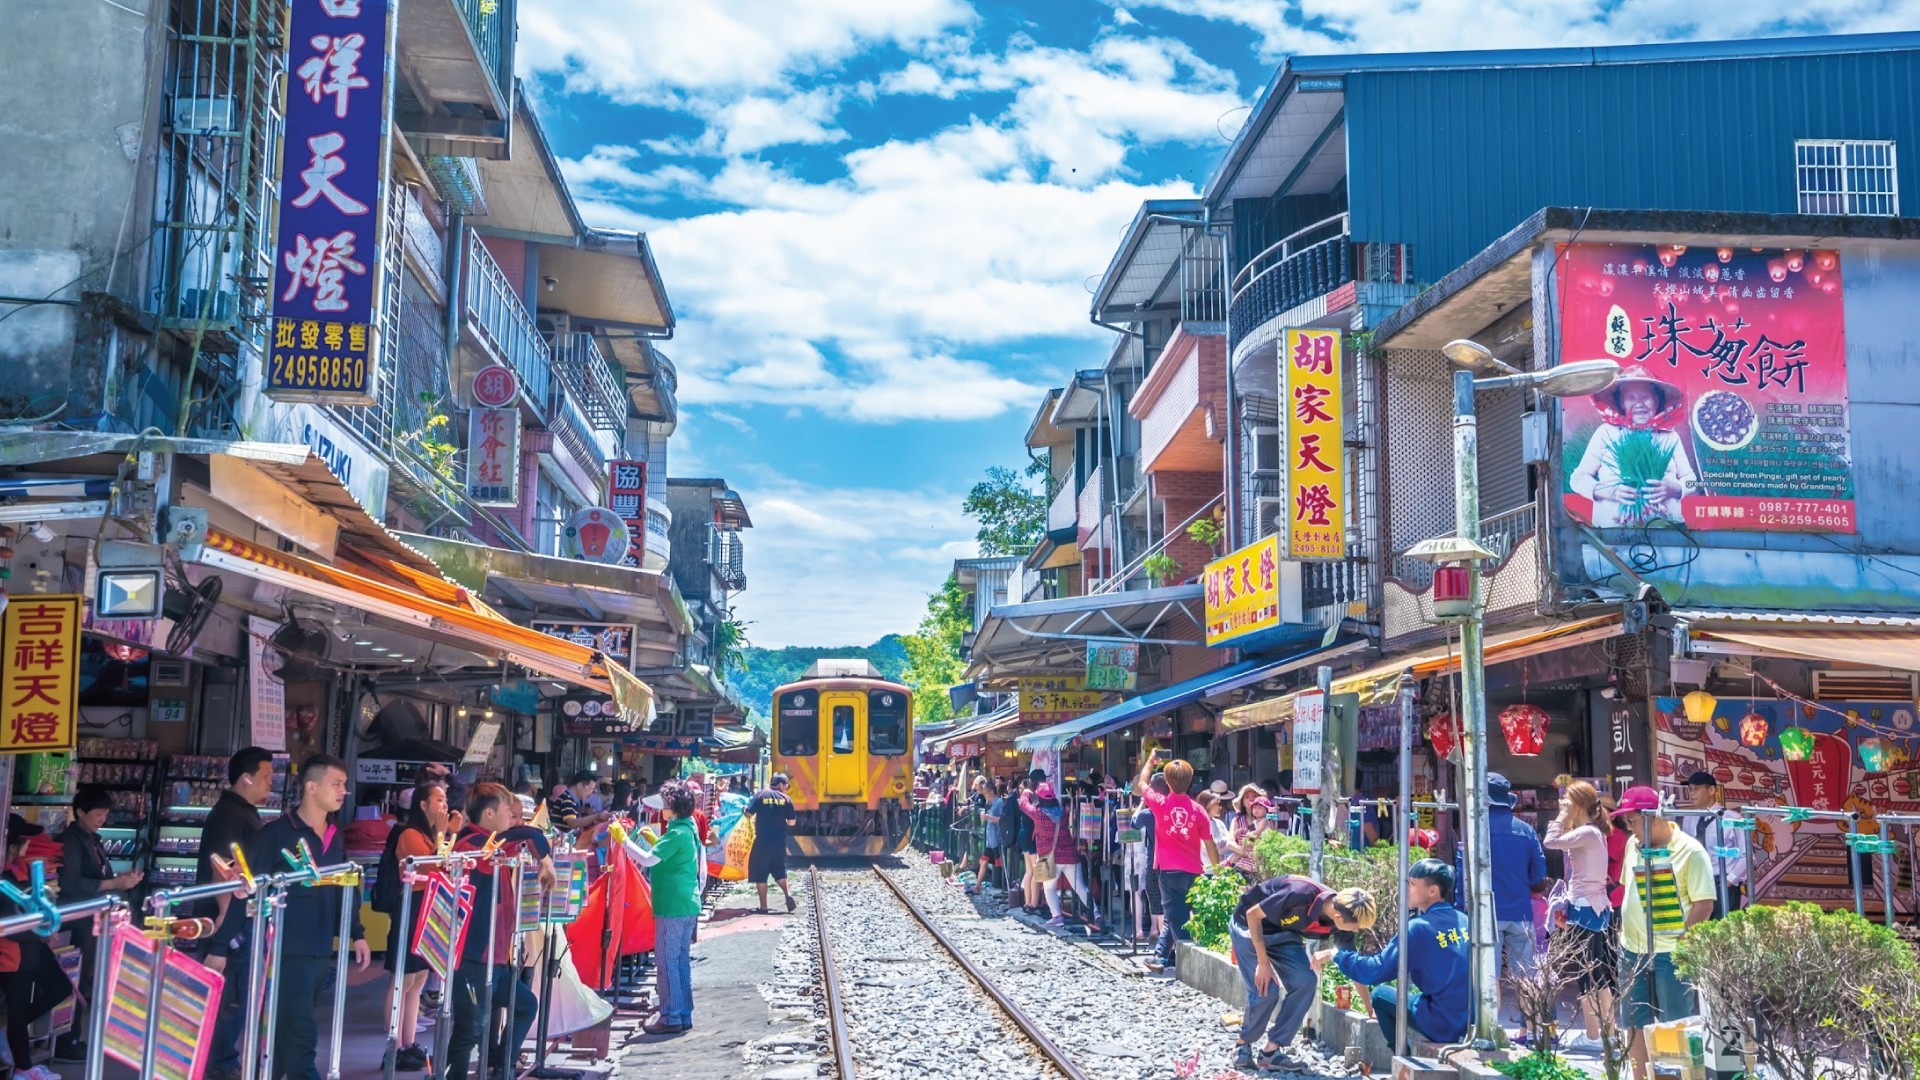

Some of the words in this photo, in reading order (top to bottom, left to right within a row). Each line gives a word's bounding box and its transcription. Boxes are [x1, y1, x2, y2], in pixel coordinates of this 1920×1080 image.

[274, 318, 368, 350] 批發零售
[1611, 315, 1629, 354] 蘇家
[272, 356, 365, 390] 24958850
[484, 373, 506, 399] 胡
[1292, 332, 1338, 526] 胡家天燈
[479, 411, 508, 483] 你會紅
[1686, 481, 1709, 489] green
[1732, 480, 1766, 488] crackers
[1767, 480, 1788, 488] made
[1789, 480, 1799, 490] by
[1800, 481, 1835, 489] Grandma
[1836, 482, 1847, 491] Su
[1703, 471, 1738, 482] Specialty
[1740, 472, 1758, 480] from
[1785, 473, 1798, 482] gift
[1813, 473, 1821, 481] of
[1822, 474, 1847, 483] pearly
[1758, 502, 1848, 514] 0987-777-401
[1759, 514, 1849, 526] 02-3259-5605
[1294, 543, 1341, 554] 2495-8131
[1207, 545, 1276, 609] 胡家天燈
[11, 604, 67, 744] 吉祥天燈
[164, 708, 180, 720] 94
[1721, 1026, 1741, 1056] 2
